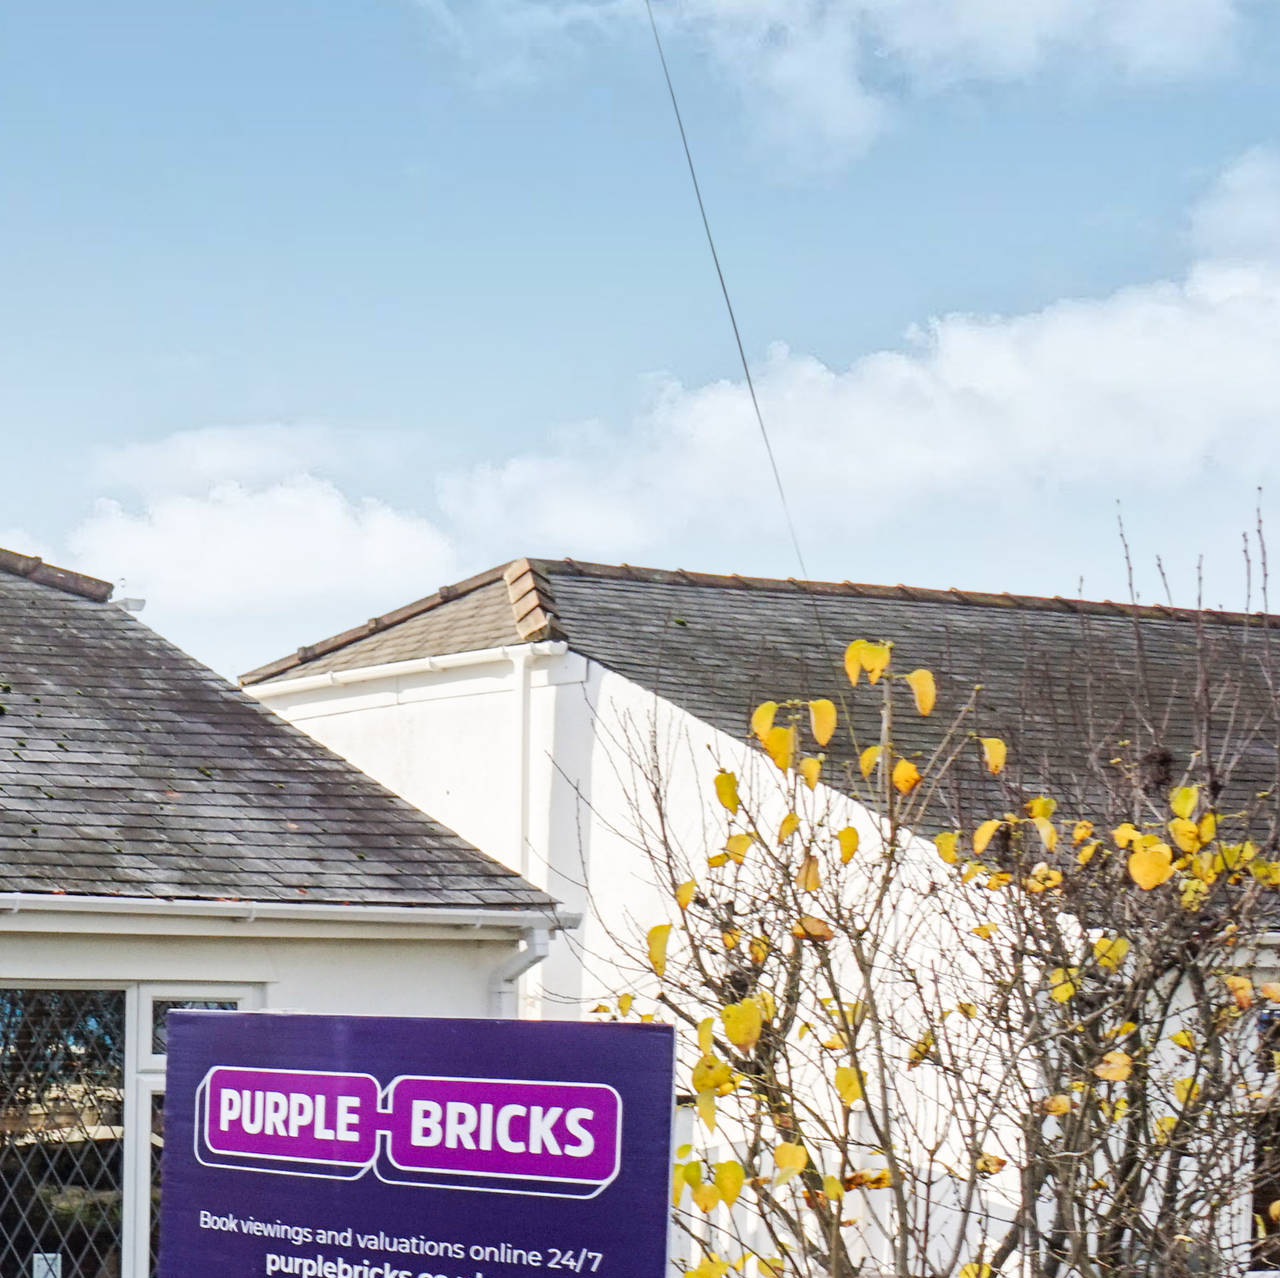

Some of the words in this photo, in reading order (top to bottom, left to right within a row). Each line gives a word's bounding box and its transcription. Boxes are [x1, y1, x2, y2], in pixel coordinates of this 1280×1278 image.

[219, 1088, 361, 1142] PURPLE
[410, 1100, 595, 1158] BRICKS
[199, 1210, 239, 1232] Book
[240, 1217, 313, 1245] viewings
[315, 1227, 353, 1247] and
[356, 1233, 465, 1259] valuations
[469, 1242, 543, 1267] online
[547, 1248, 604, 1273] 24/7
